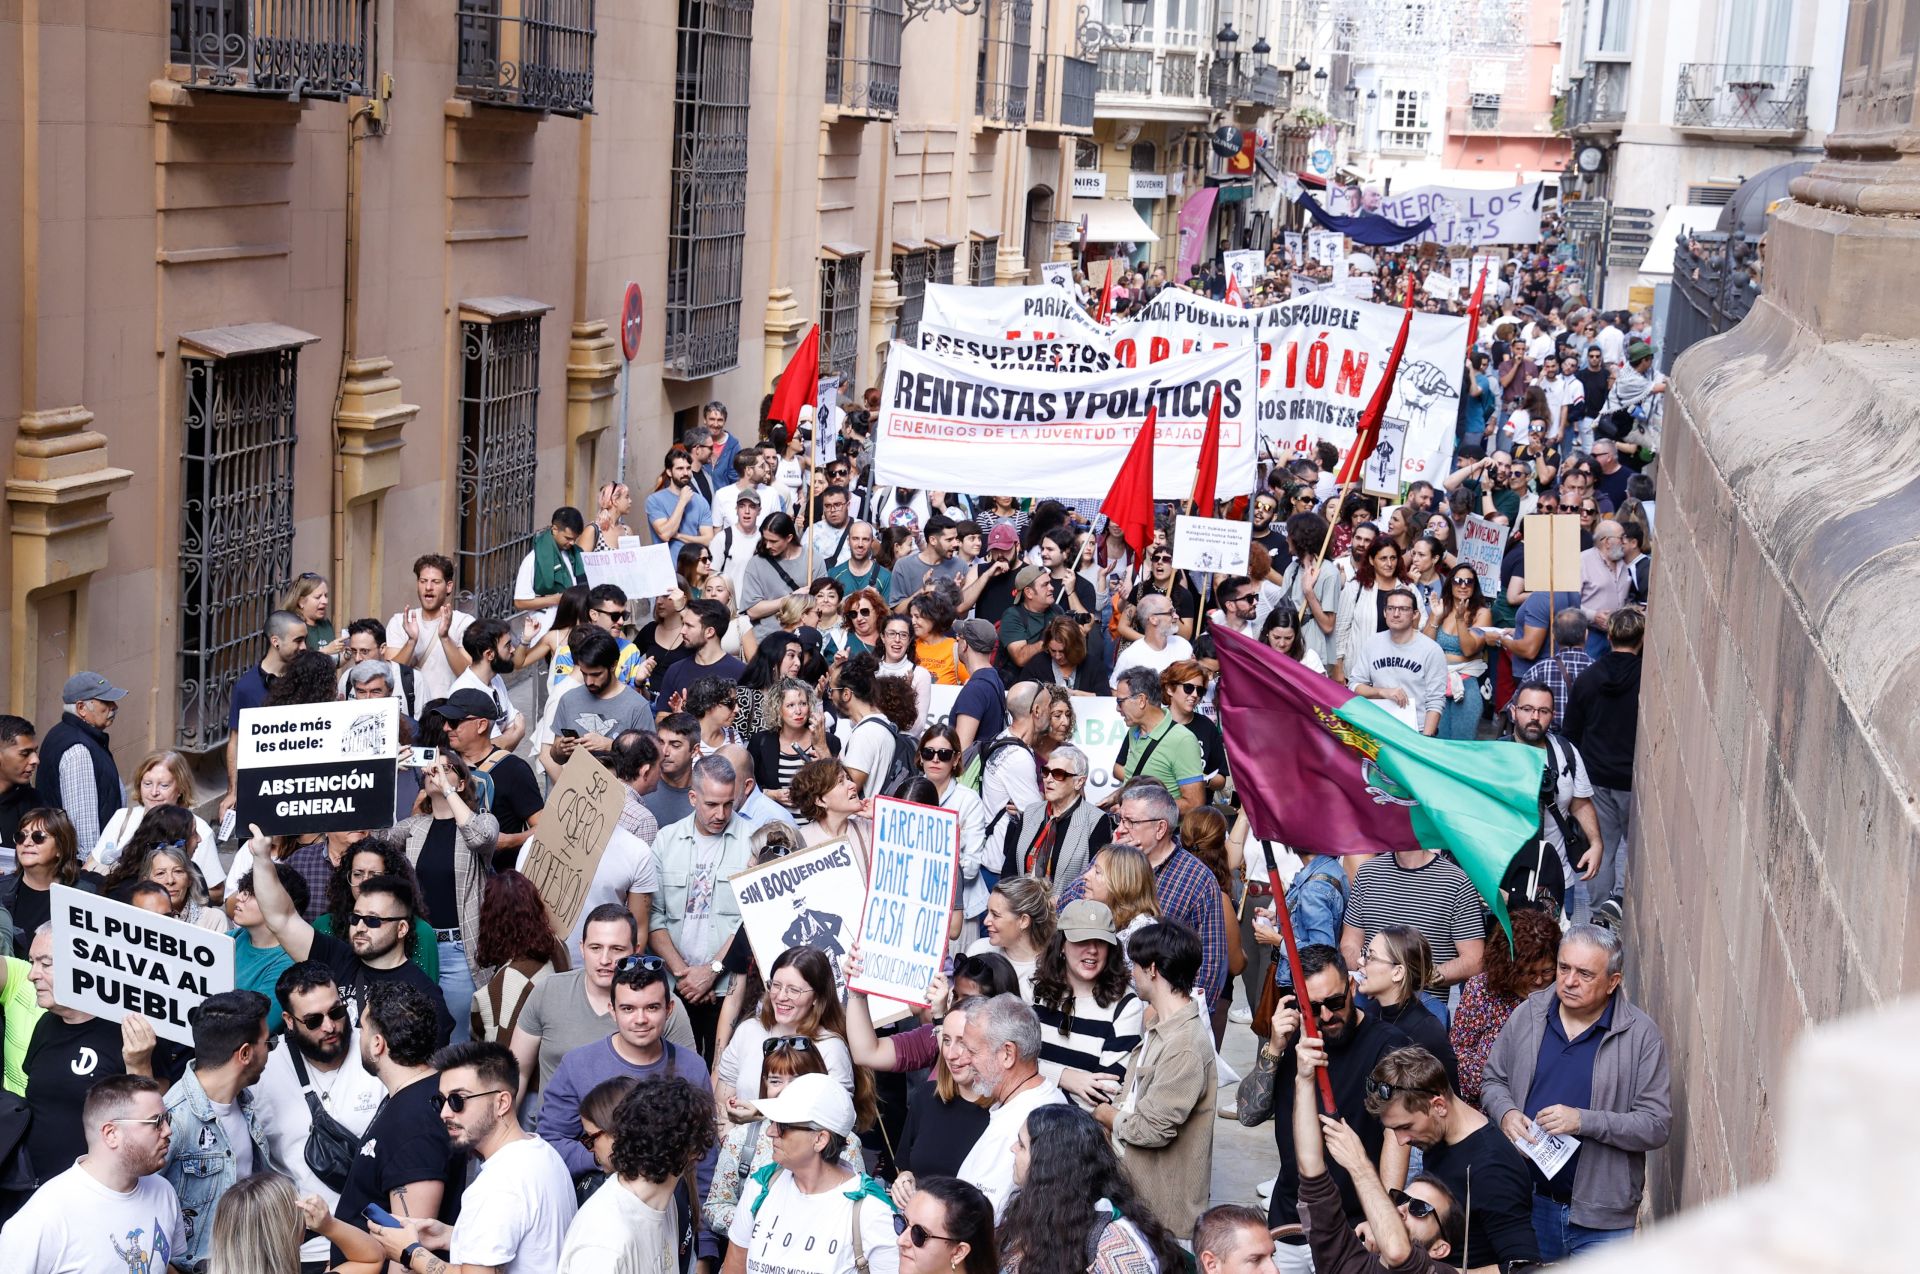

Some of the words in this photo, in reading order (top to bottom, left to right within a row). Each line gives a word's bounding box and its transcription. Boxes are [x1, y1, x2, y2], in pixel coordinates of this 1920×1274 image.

[1074, 178, 1100, 187] NIRS
[1136, 180, 1164, 188] SOUVENIRS
[1470, 192, 1522, 218] LOS
[1175, 301, 1249, 328] PÚBLICA
[1268, 304, 1360, 330] ASEQUIBLE
[921, 331, 1108, 371] PRESUPUESTOS
[893, 370, 1057, 422] RENTISTAS
[1064, 391, 1083, 419] Y
[1085, 378, 1242, 419] POLÍTICOS
[893, 419, 977, 437] ENEMIGOS
[984, 425, 1003, 438] DE
[1010, 426, 1029, 439] LA
[1034, 426, 1116, 440] JUVENTUD
[614, 551, 637, 564] PODER
[1373, 657, 1422, 673] TIMBERLAND
[251, 720, 297, 736] Donde
[300, 717, 332, 732] más
[255, 740, 276, 753] les
[278, 737, 324, 752] duele:
[258, 768, 375, 796] ABSTENCIÓN
[586, 770, 608, 803] SER
[275, 797, 356, 817] GENERAL
[558, 788, 605, 855] CASERO
[879, 807, 952, 857] ¡ARCARDE
[740, 881, 764, 905] SIN
[761, 844, 851, 901] BOQUERONES
[875, 847, 914, 897] DAME
[920, 858, 949, 907] UNA
[69, 905, 99, 934] EL
[104, 916, 215, 968] PUEBLO
[865, 896, 906, 948] CASA
[913, 906, 944, 957] QUE
[72, 937, 170, 985] SALVA
[177, 971, 213, 998] AL
[1541, 1147, 1557, 1167] HUELG
